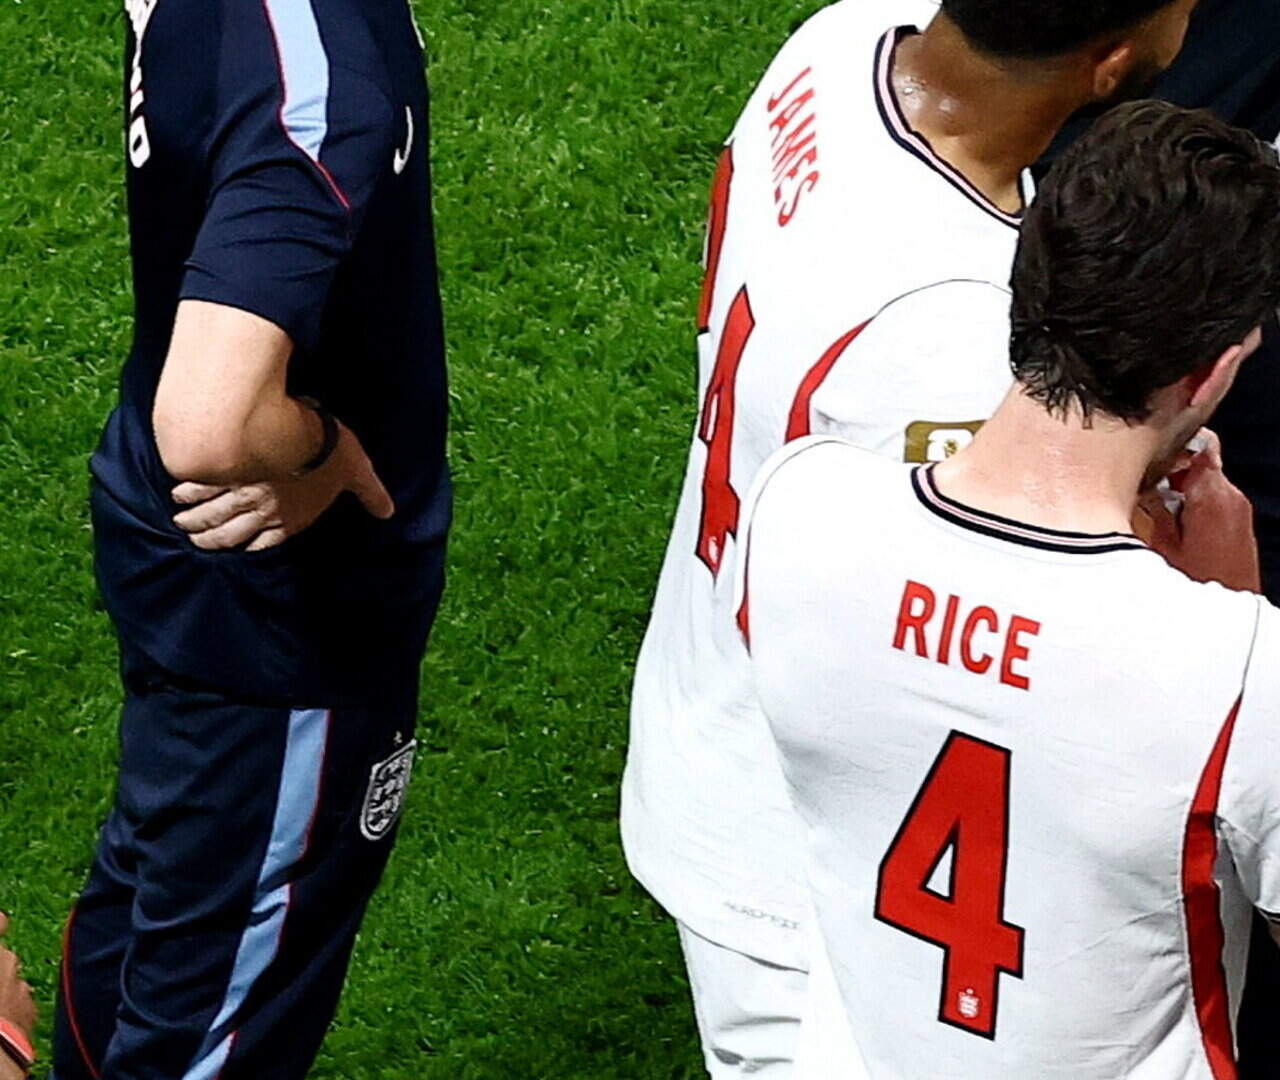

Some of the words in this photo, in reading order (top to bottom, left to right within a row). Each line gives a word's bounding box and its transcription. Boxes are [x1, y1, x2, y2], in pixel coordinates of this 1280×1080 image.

[767, 66, 820, 227] JAMES
[892, 580, 1042, 690] RICE
[873, 729, 1026, 1041] 4
